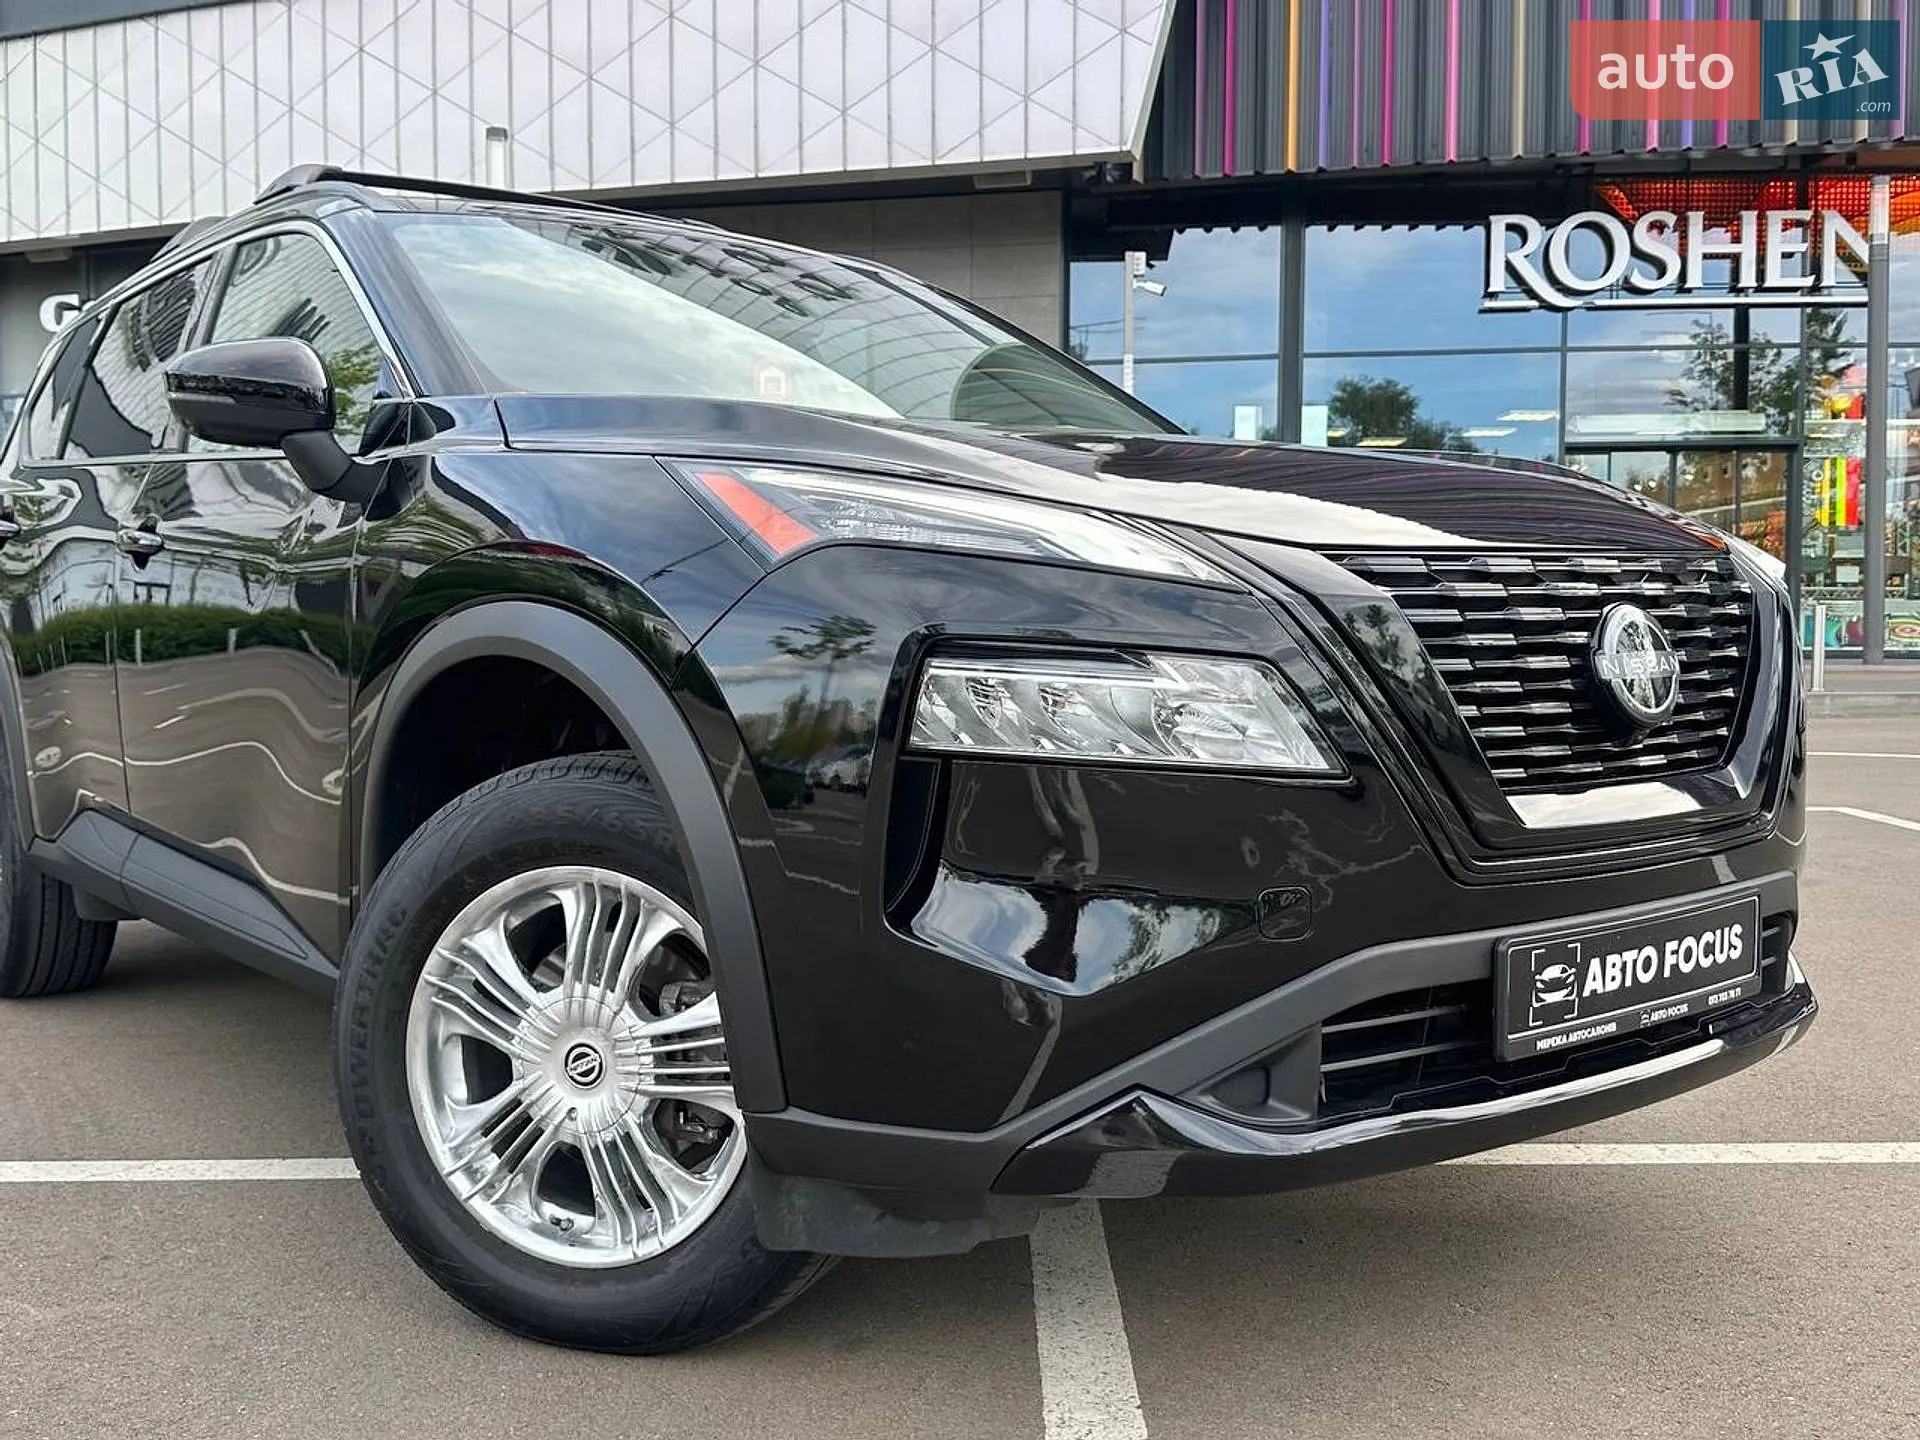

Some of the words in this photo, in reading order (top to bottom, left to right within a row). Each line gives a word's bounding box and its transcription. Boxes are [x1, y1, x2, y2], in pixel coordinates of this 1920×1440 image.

[1487, 210, 1869, 309] ROSHEN
[39, 294, 96, 332] G
[1601, 653, 1680, 675] NISSAN
[1663, 923, 1743, 978] FOCUS
